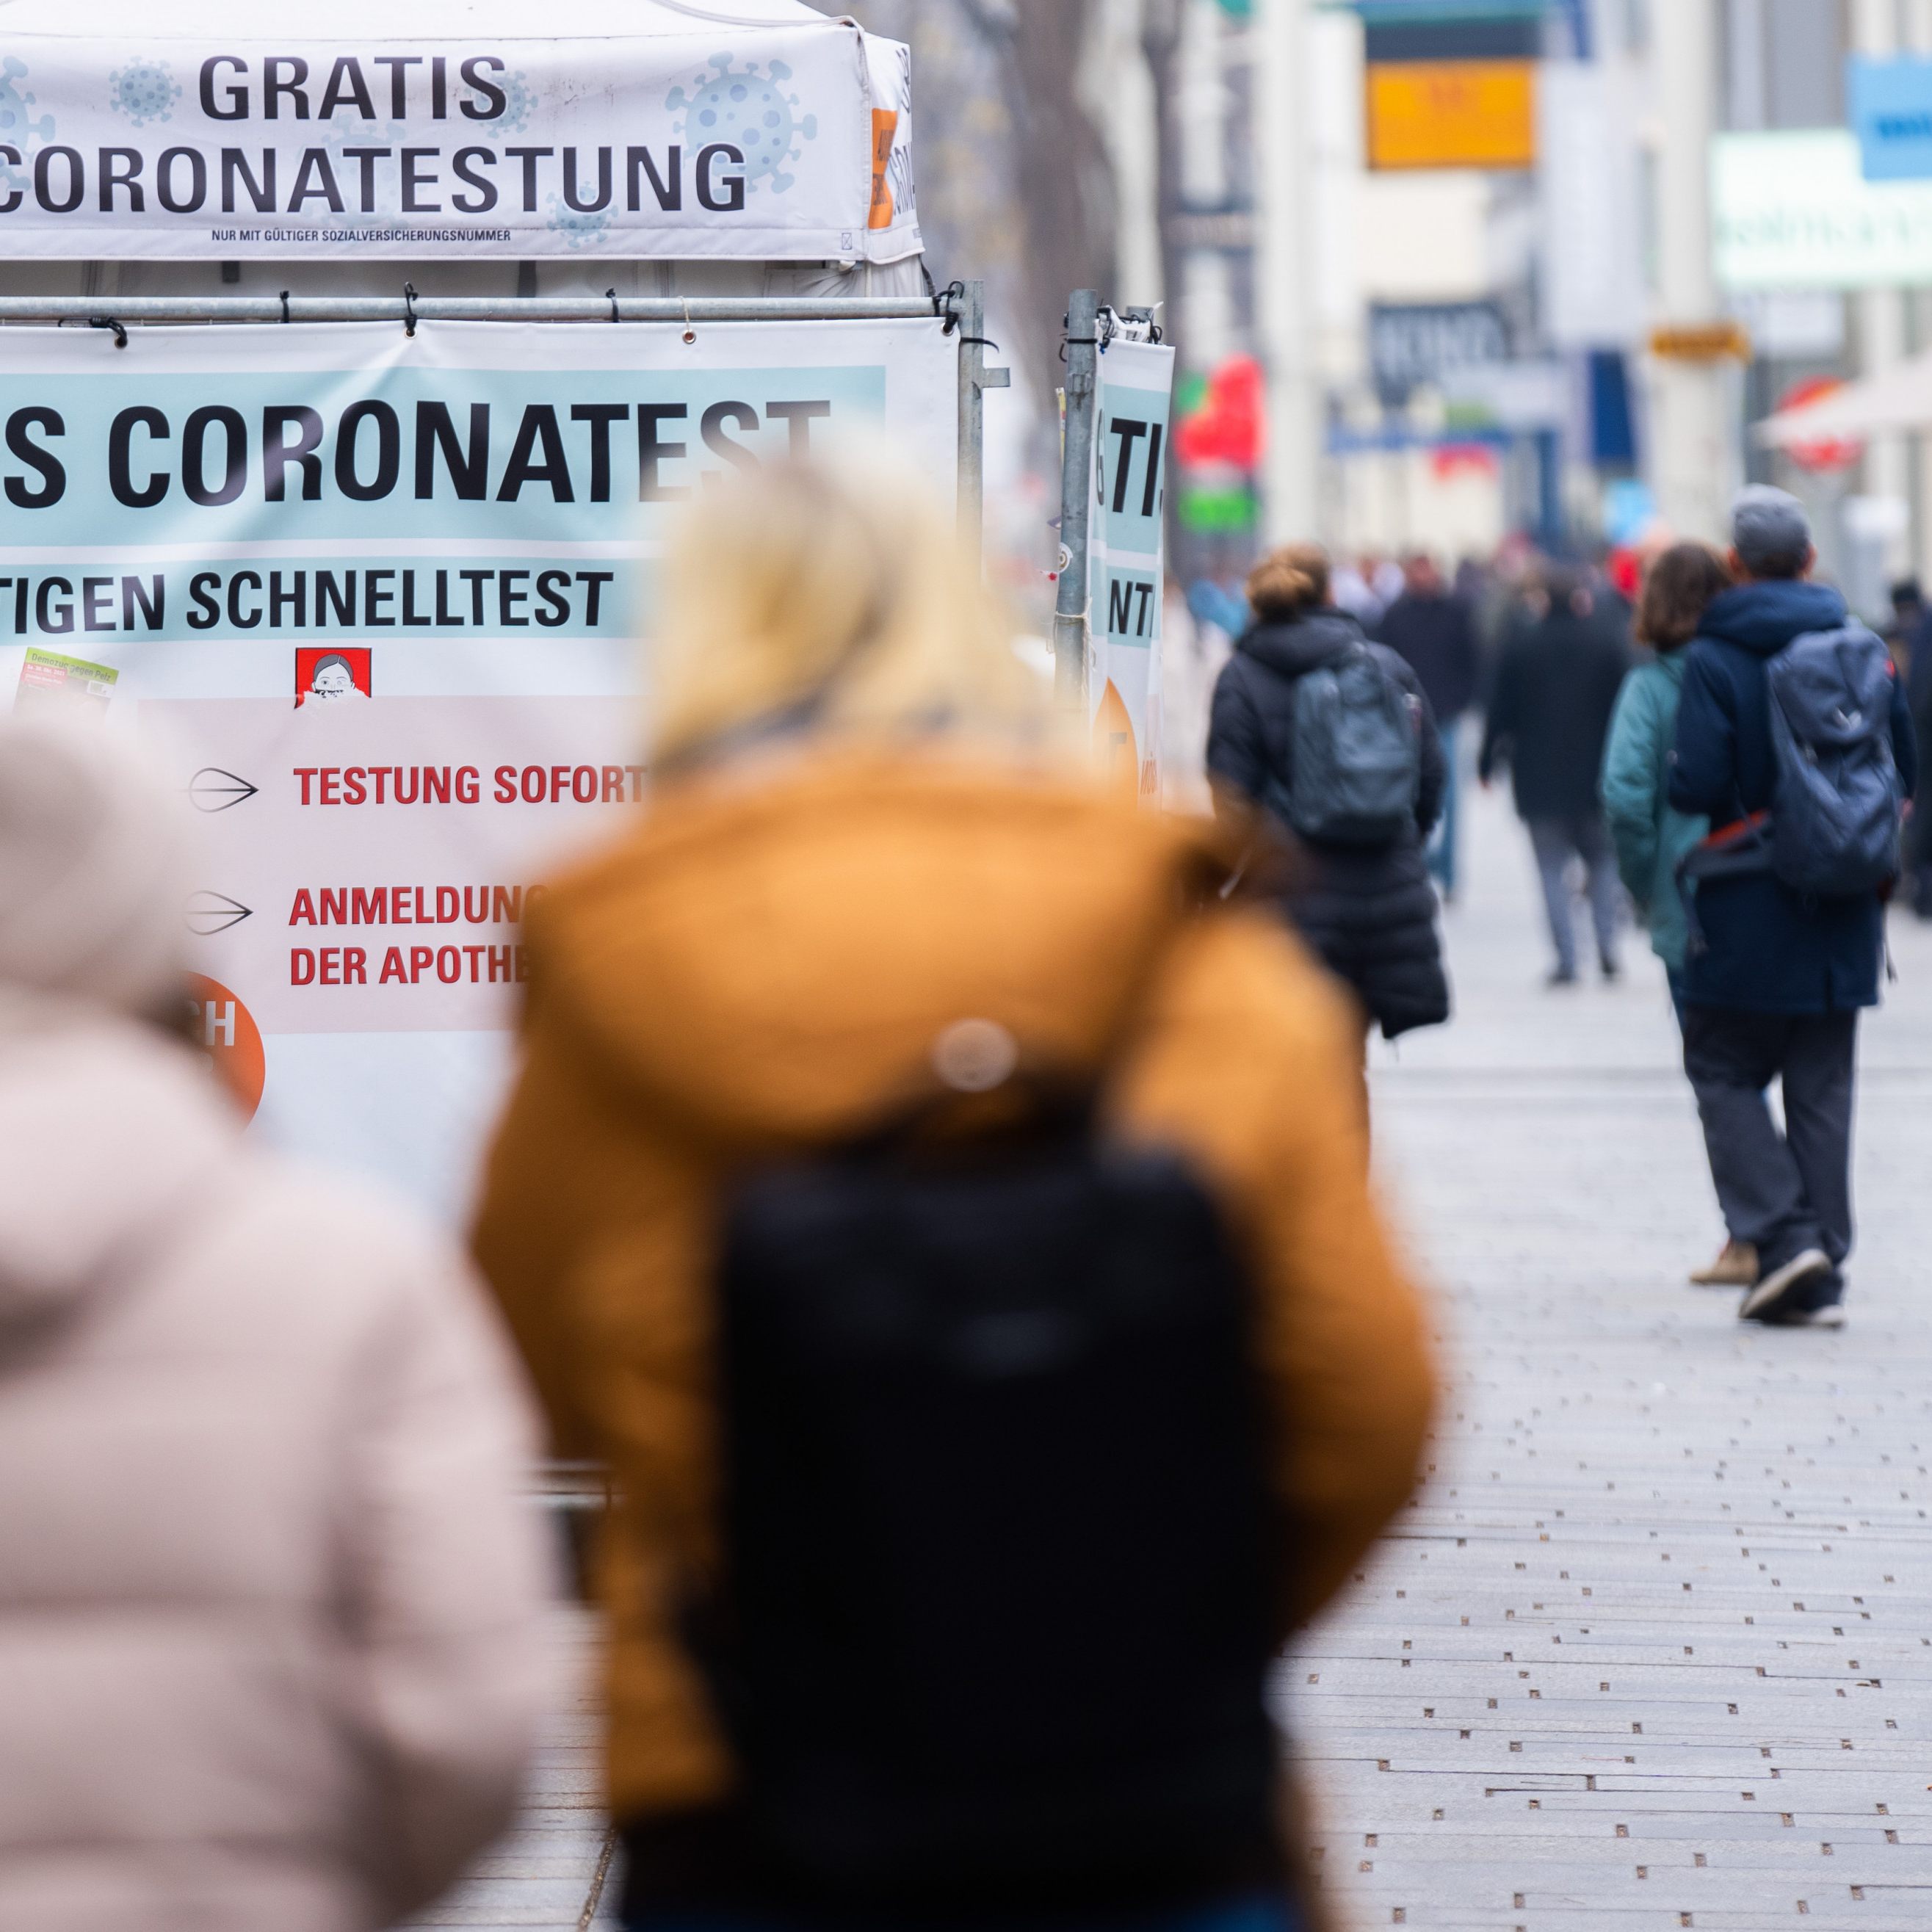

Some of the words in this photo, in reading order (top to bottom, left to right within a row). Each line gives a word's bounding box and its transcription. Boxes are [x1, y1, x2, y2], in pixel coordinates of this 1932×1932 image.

[199, 56, 507, 120] GRATIS
[211, 230, 236, 241] NUR
[239, 230, 261, 241] MIT
[264, 228, 319, 241] GÜLTIGER
[322, 229, 511, 242] SOZIALVERSICHERUNGSNUMMER
[108, 399, 831, 508] CORONATEST
[186, 569, 615, 630] SCHNELLTEST
[95, 670, 112, 681] Pelz
[293, 765, 480, 806] TESTUNG
[493, 764, 648, 804] SOFORT
[290, 947, 367, 985] DER
